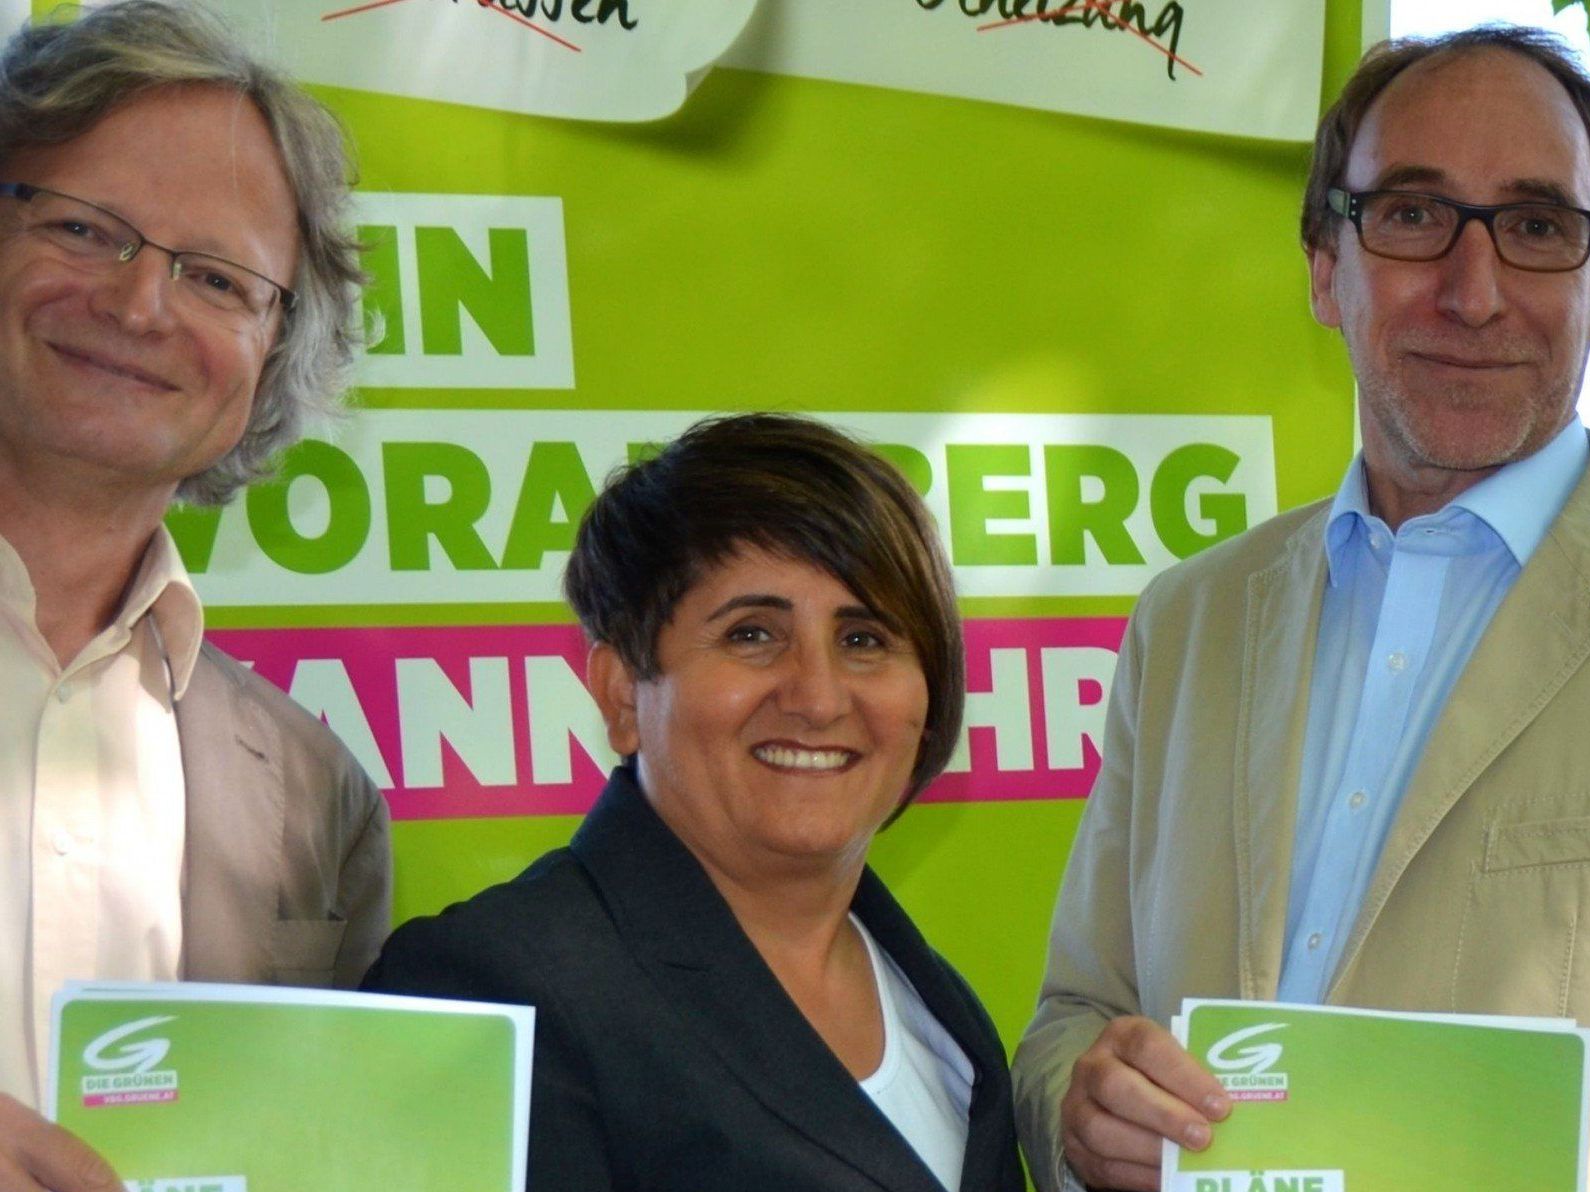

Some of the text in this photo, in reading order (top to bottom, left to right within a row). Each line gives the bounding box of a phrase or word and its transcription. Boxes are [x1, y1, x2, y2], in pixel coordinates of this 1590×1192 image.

[356, 225, 536, 356] IN
[242, 655, 617, 790] ANN
[86, 1073, 174, 1090] DIE GRÜNEN
[1231, 1075, 1284, 1087] GRÜNEN
